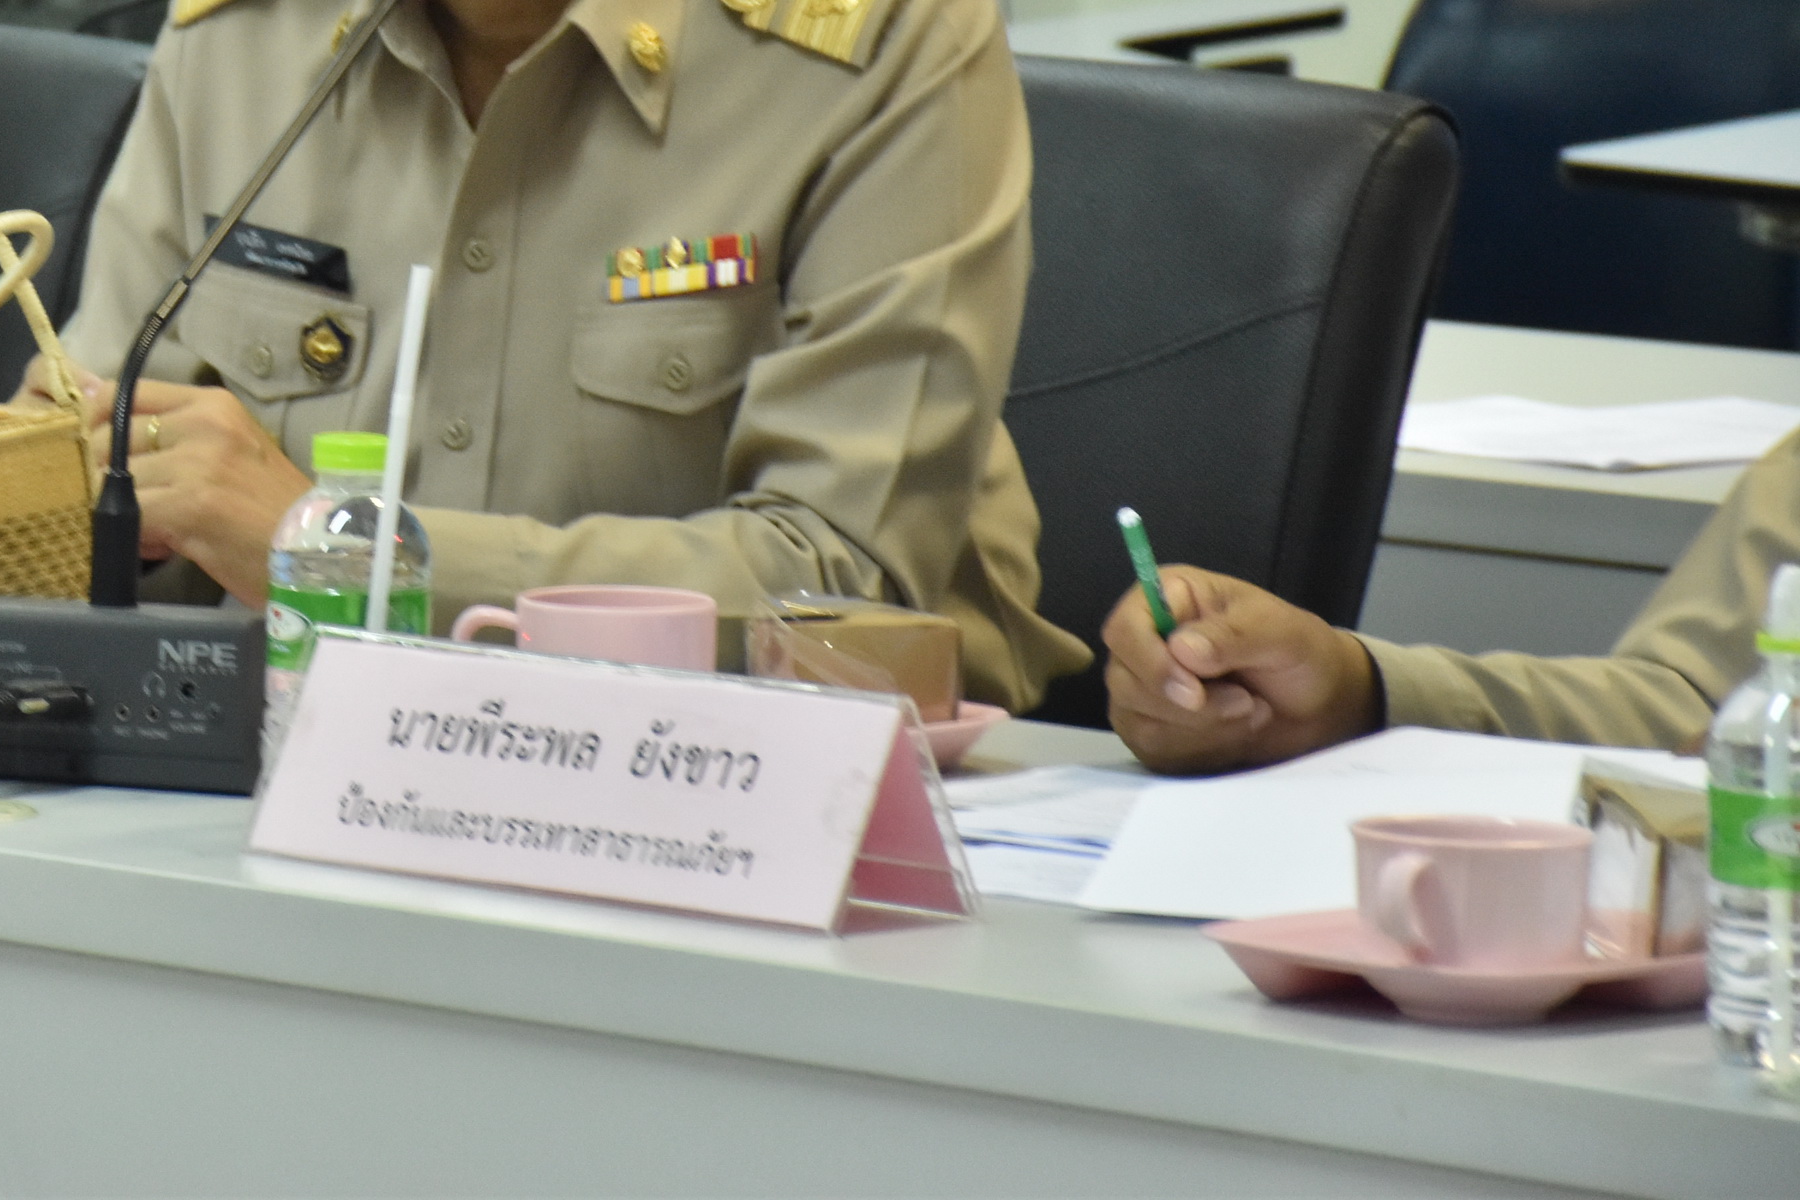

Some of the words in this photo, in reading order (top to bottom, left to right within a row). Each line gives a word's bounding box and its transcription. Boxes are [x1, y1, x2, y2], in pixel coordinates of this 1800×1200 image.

[157, 638, 238, 668] NPE
[388, 699, 602, 772] นายพีระพล
[630, 718, 762, 793] ยังขาว
